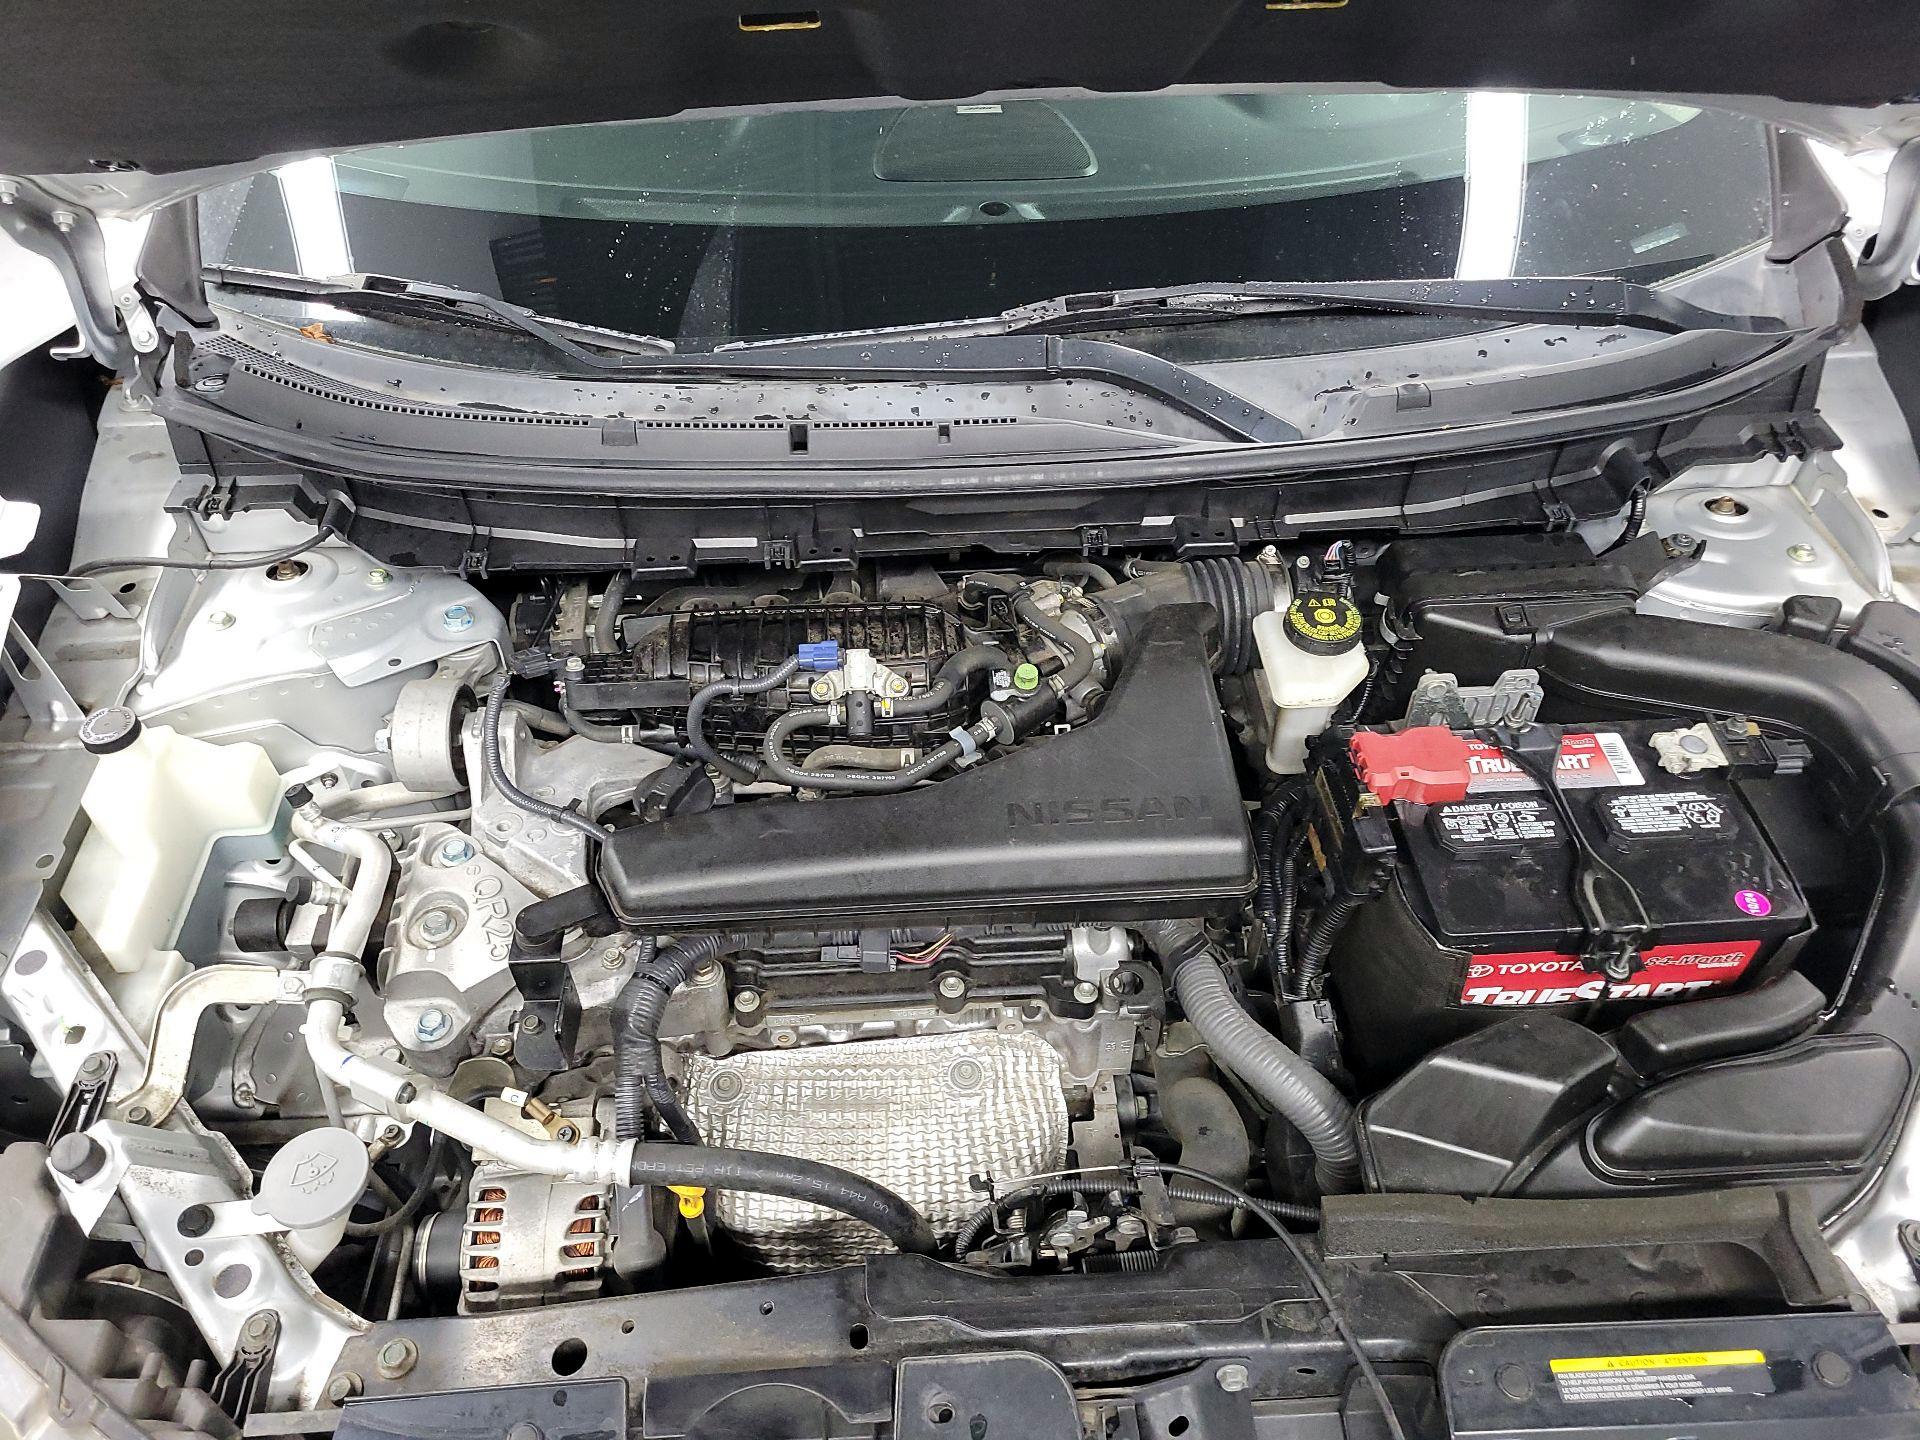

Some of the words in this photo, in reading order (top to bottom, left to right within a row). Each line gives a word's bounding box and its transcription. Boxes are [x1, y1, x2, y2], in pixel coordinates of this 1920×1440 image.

[1006, 796, 1213, 828] NISSAN
[1452, 803, 1493, 813] DANGER
[1500, 801, 1539, 810] POISON
[472, 874, 515, 961] QR25
[1499, 961, 1585, 975] TOYOTA
[1618, 1358, 1655, 1367] CAUTION
